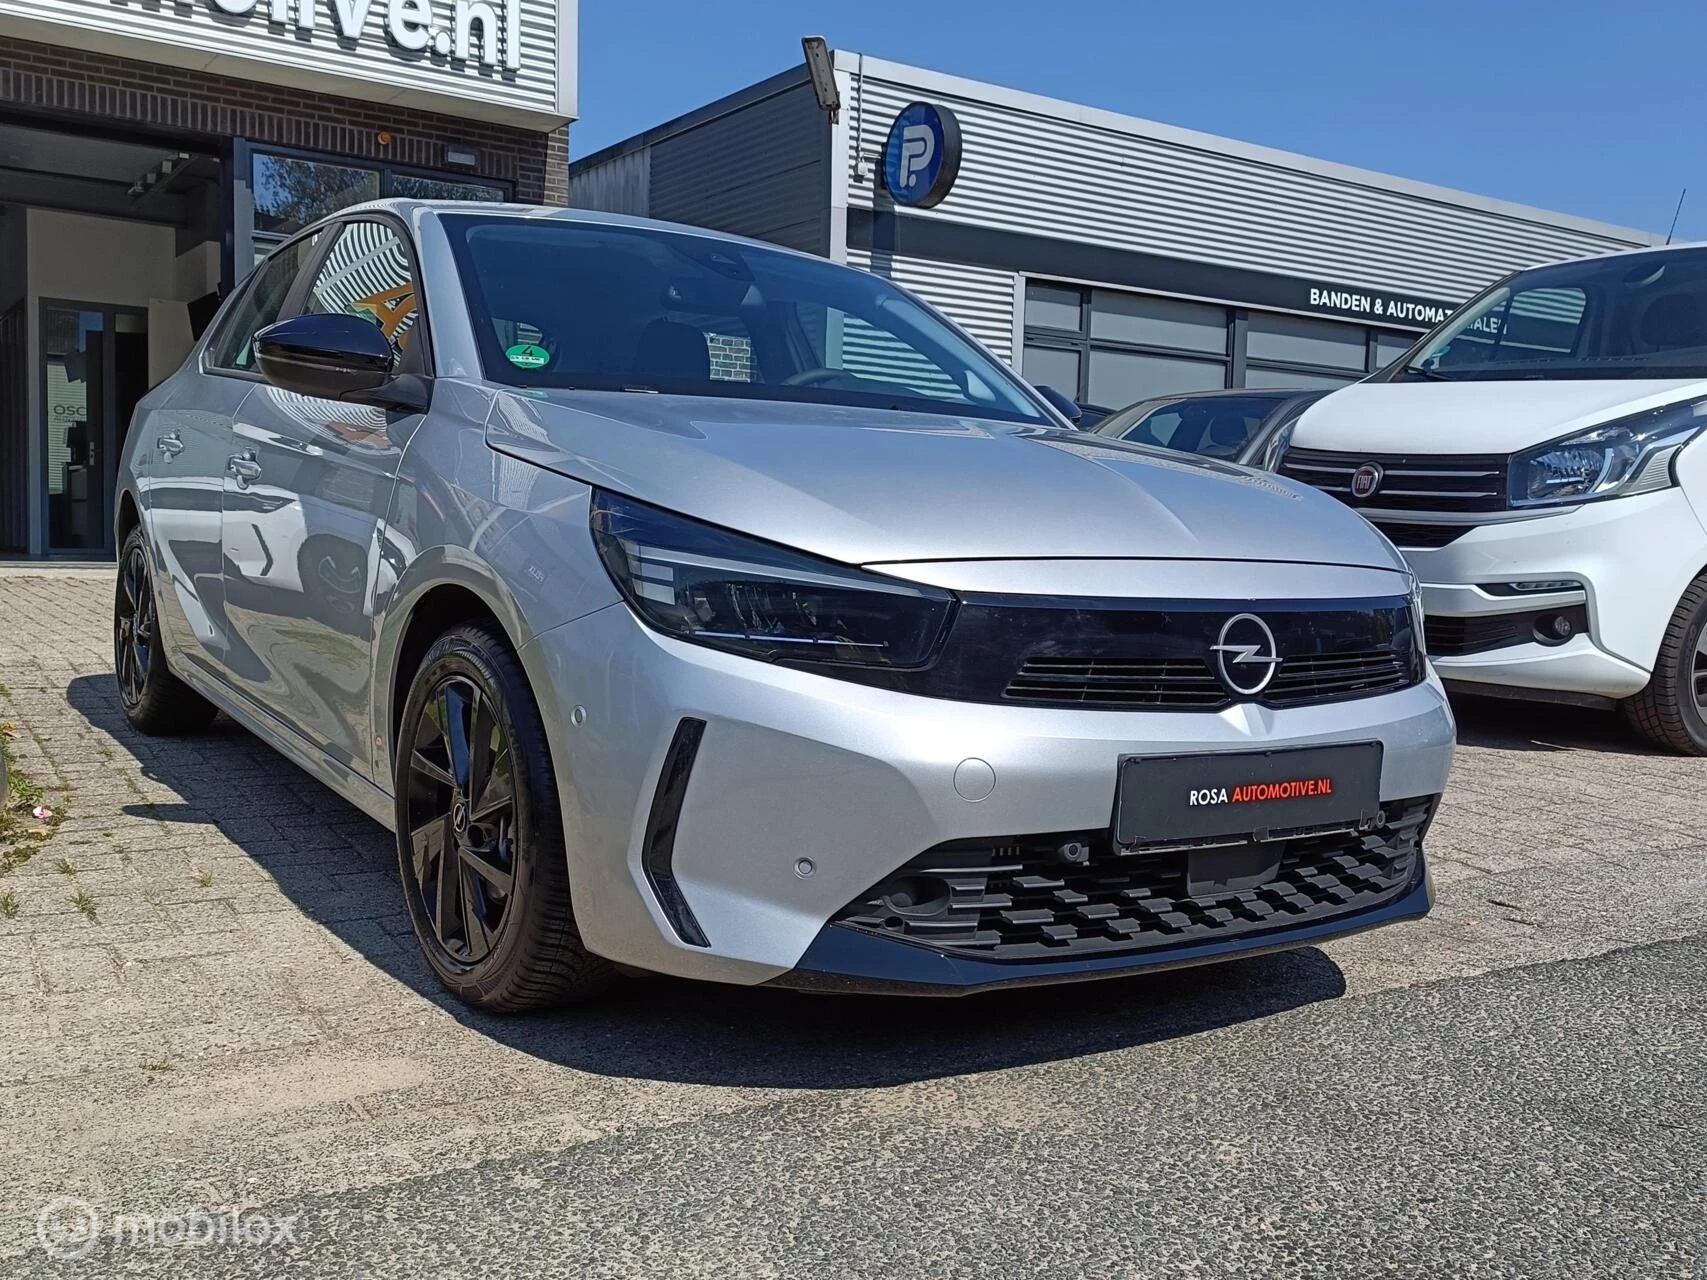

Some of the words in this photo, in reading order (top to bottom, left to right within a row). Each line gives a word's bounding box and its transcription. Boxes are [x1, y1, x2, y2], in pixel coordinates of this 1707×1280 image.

[1310, 288, 1371, 312] BANDEN
[1374, 298, 1384, 315] &
[521, 345, 533, 357] 4
[1356, 475, 1373, 489] FIAT
[1189, 787, 1229, 806] ROSA
[1231, 778, 1332, 803] AUTOMOTIVE.NL
